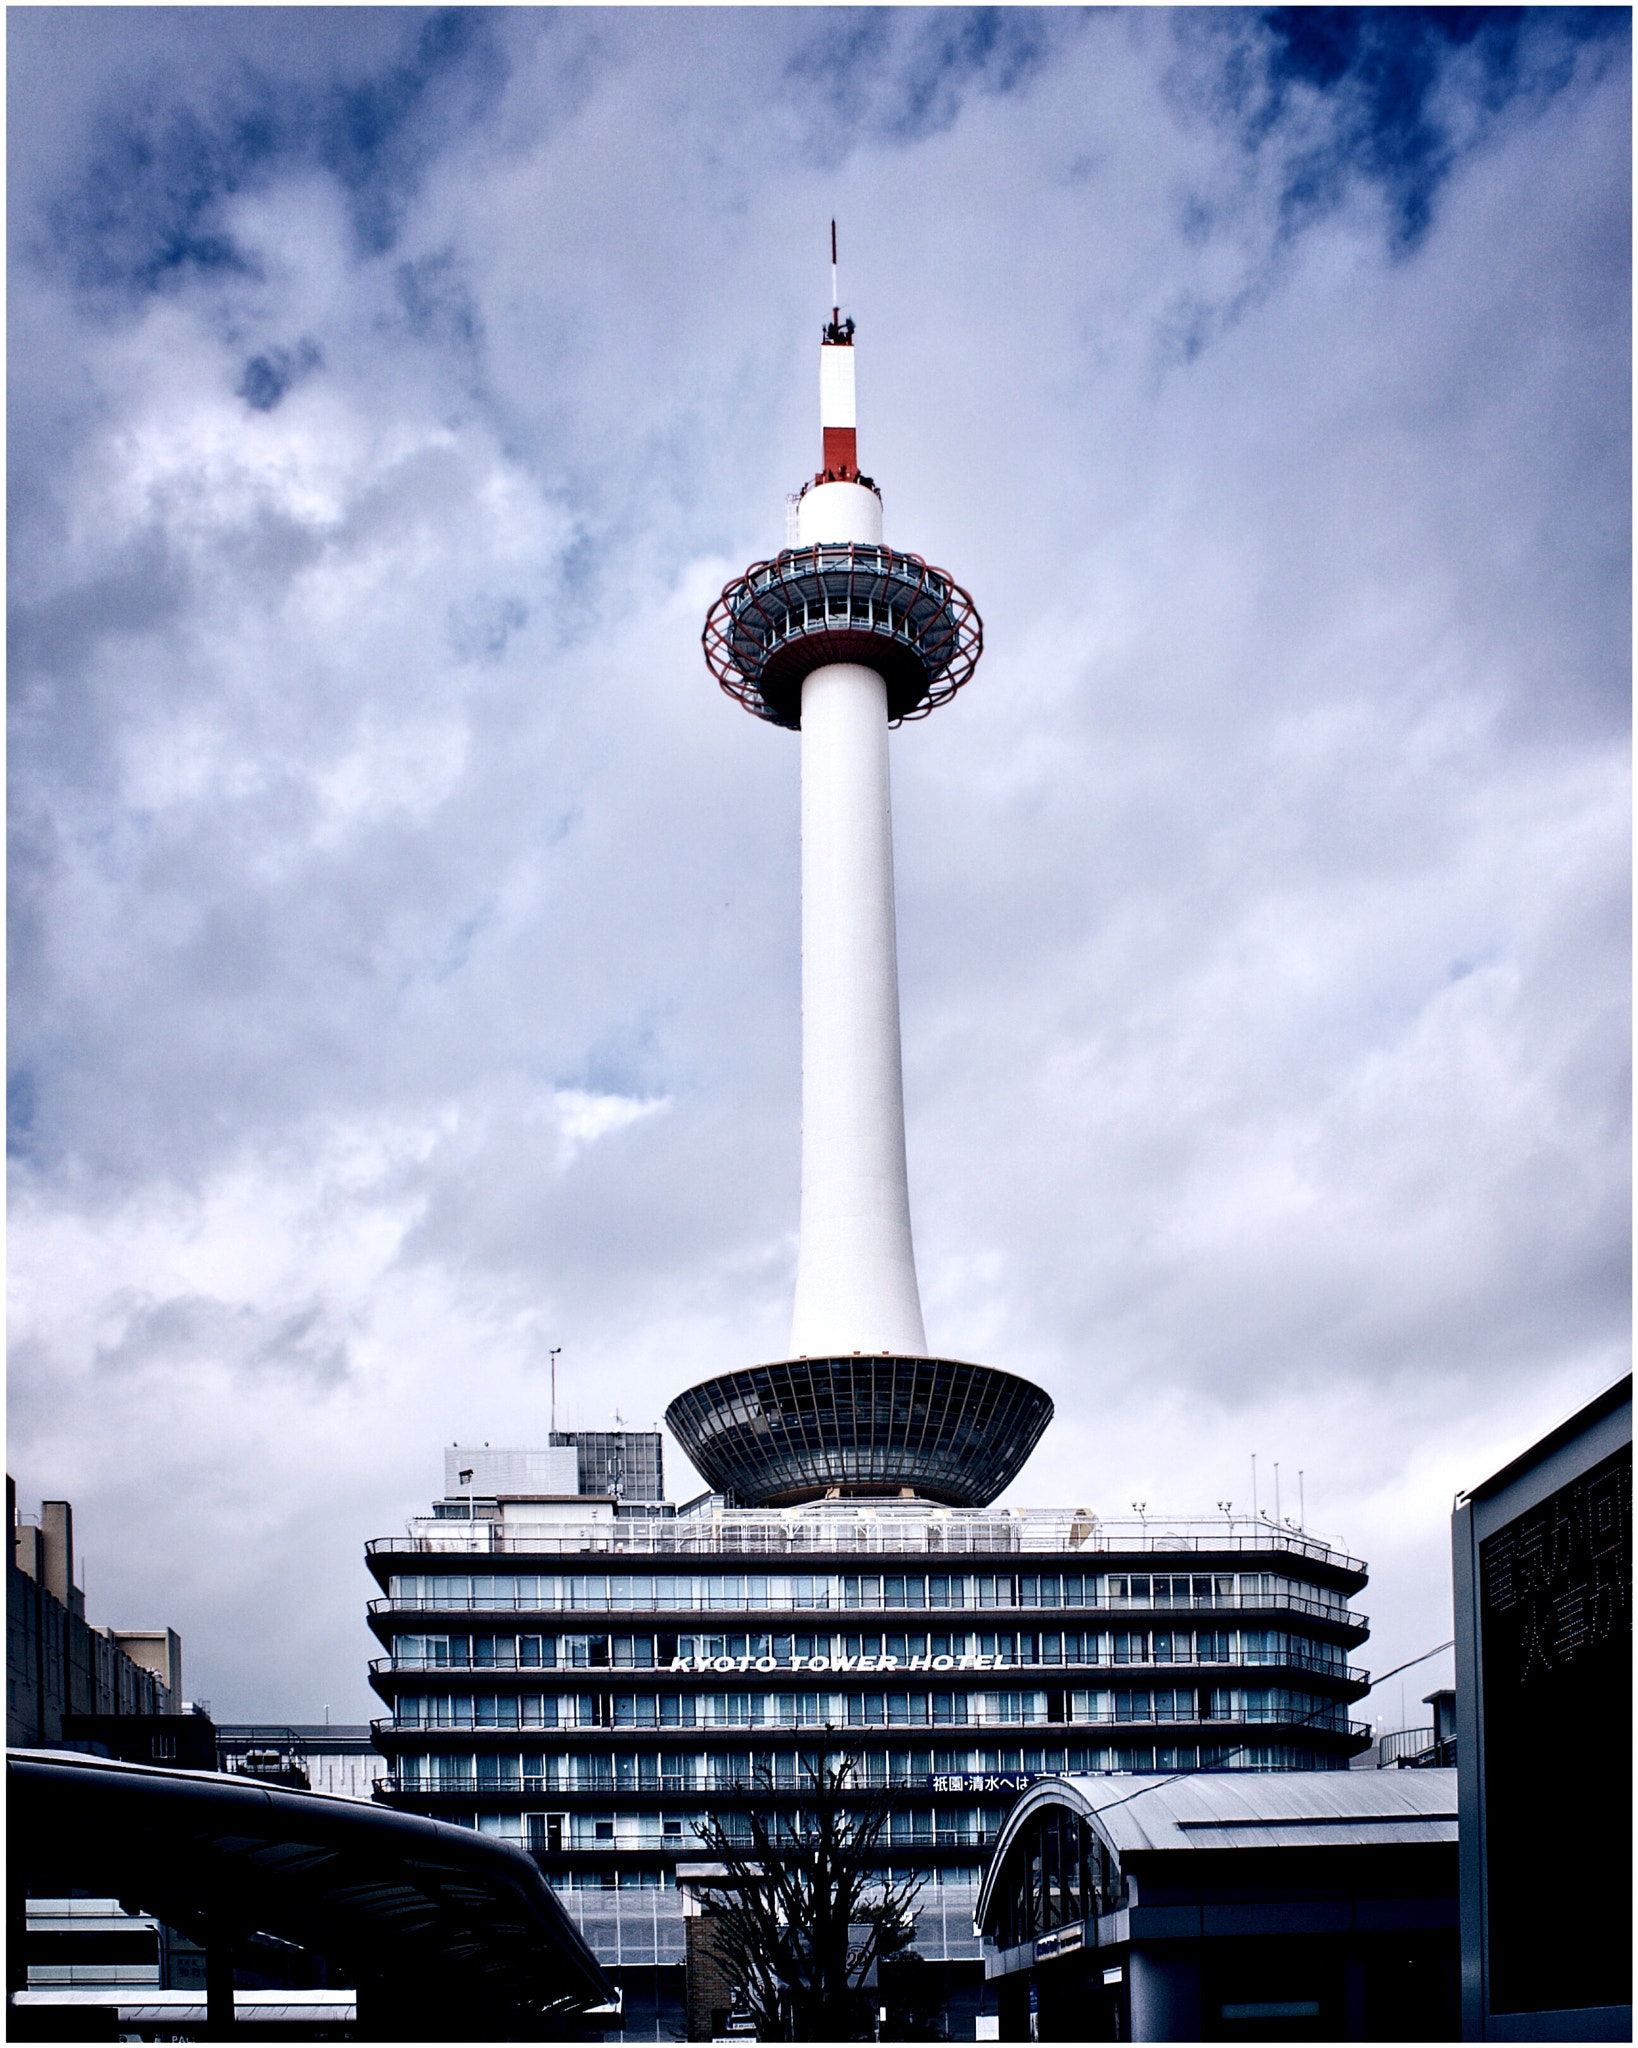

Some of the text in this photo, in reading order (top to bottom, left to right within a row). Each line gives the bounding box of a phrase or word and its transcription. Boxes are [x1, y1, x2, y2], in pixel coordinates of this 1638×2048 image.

[1485, 1465, 1632, 1612] 電気が回
[669, 1654, 1011, 1673] KYOTO TOWER HOTEL
